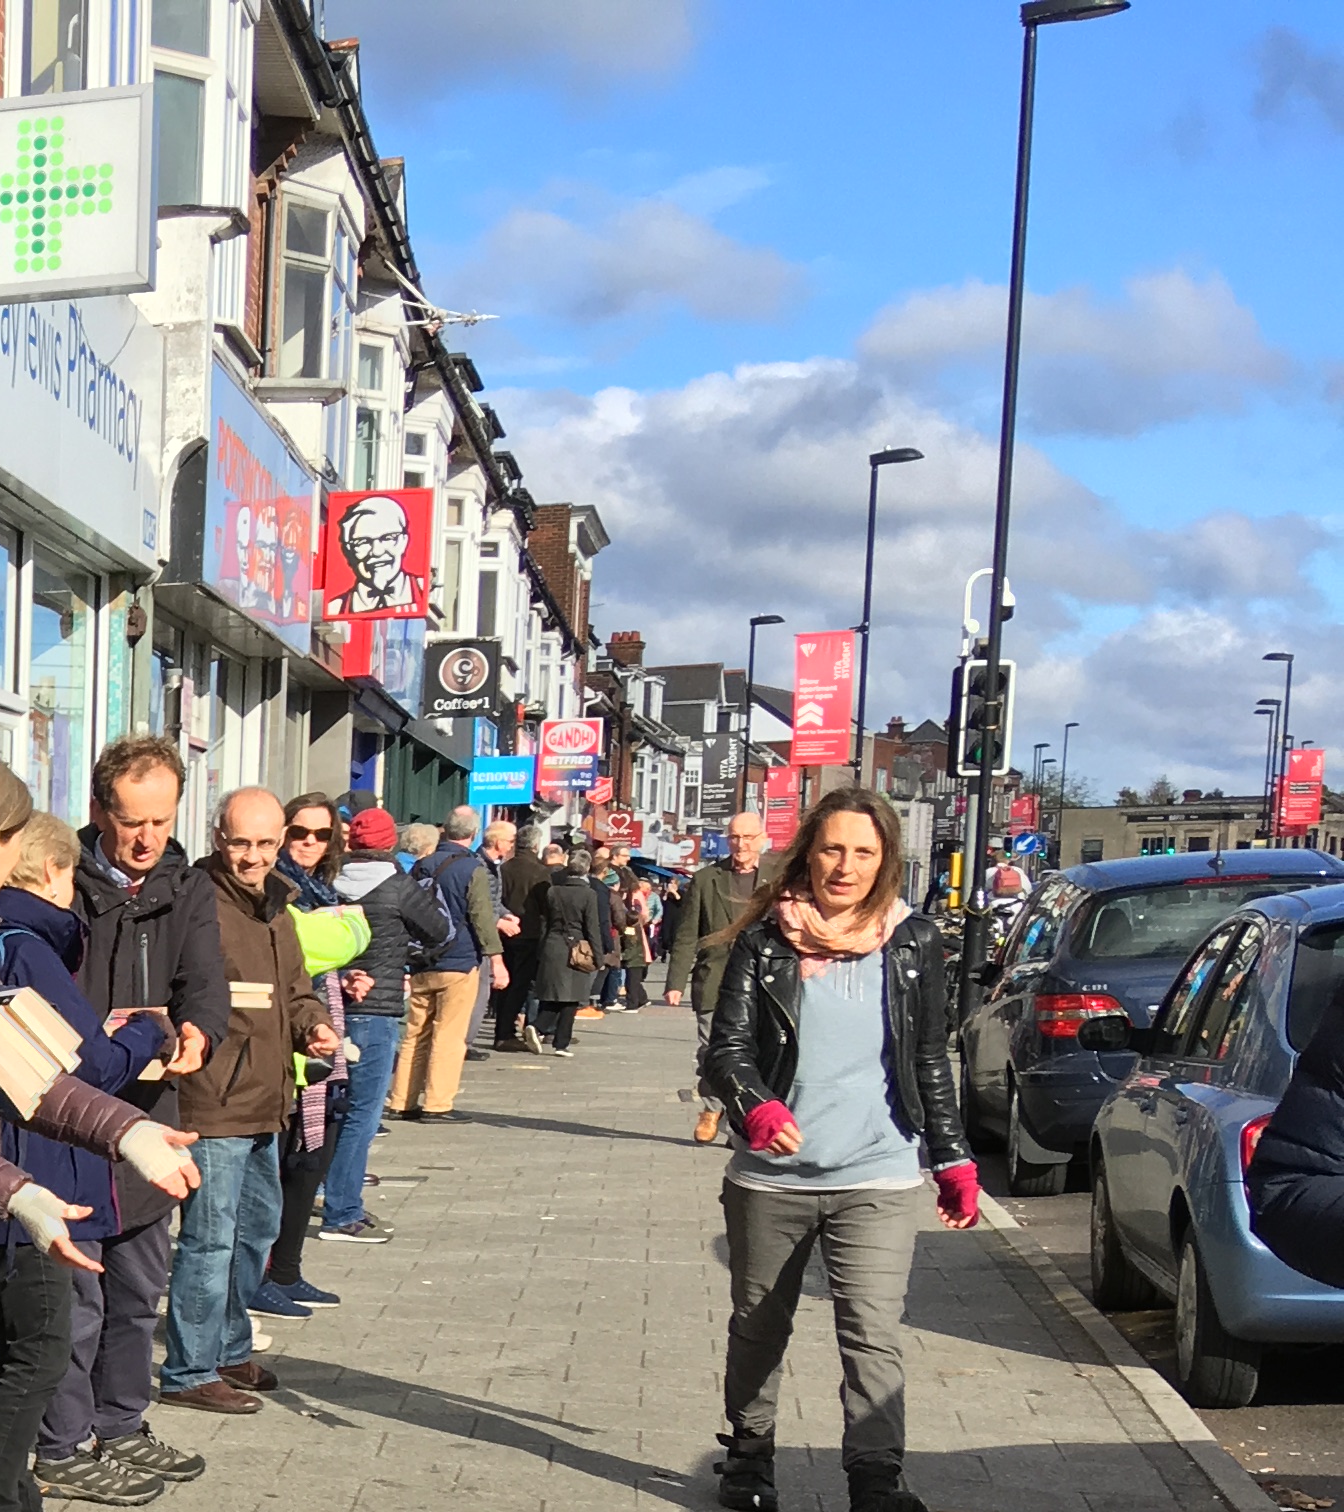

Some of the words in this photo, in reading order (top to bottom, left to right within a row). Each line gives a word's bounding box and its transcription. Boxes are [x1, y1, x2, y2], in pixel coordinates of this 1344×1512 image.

[67, 302, 143, 491] Pharmacy
[548, 726, 594, 749] GANDHI
[543, 755, 593, 765] BETFRED
[719, 759, 729, 780] VITA
[728, 738, 738, 779] STUDENT
[473, 770, 525, 783] tenovus
